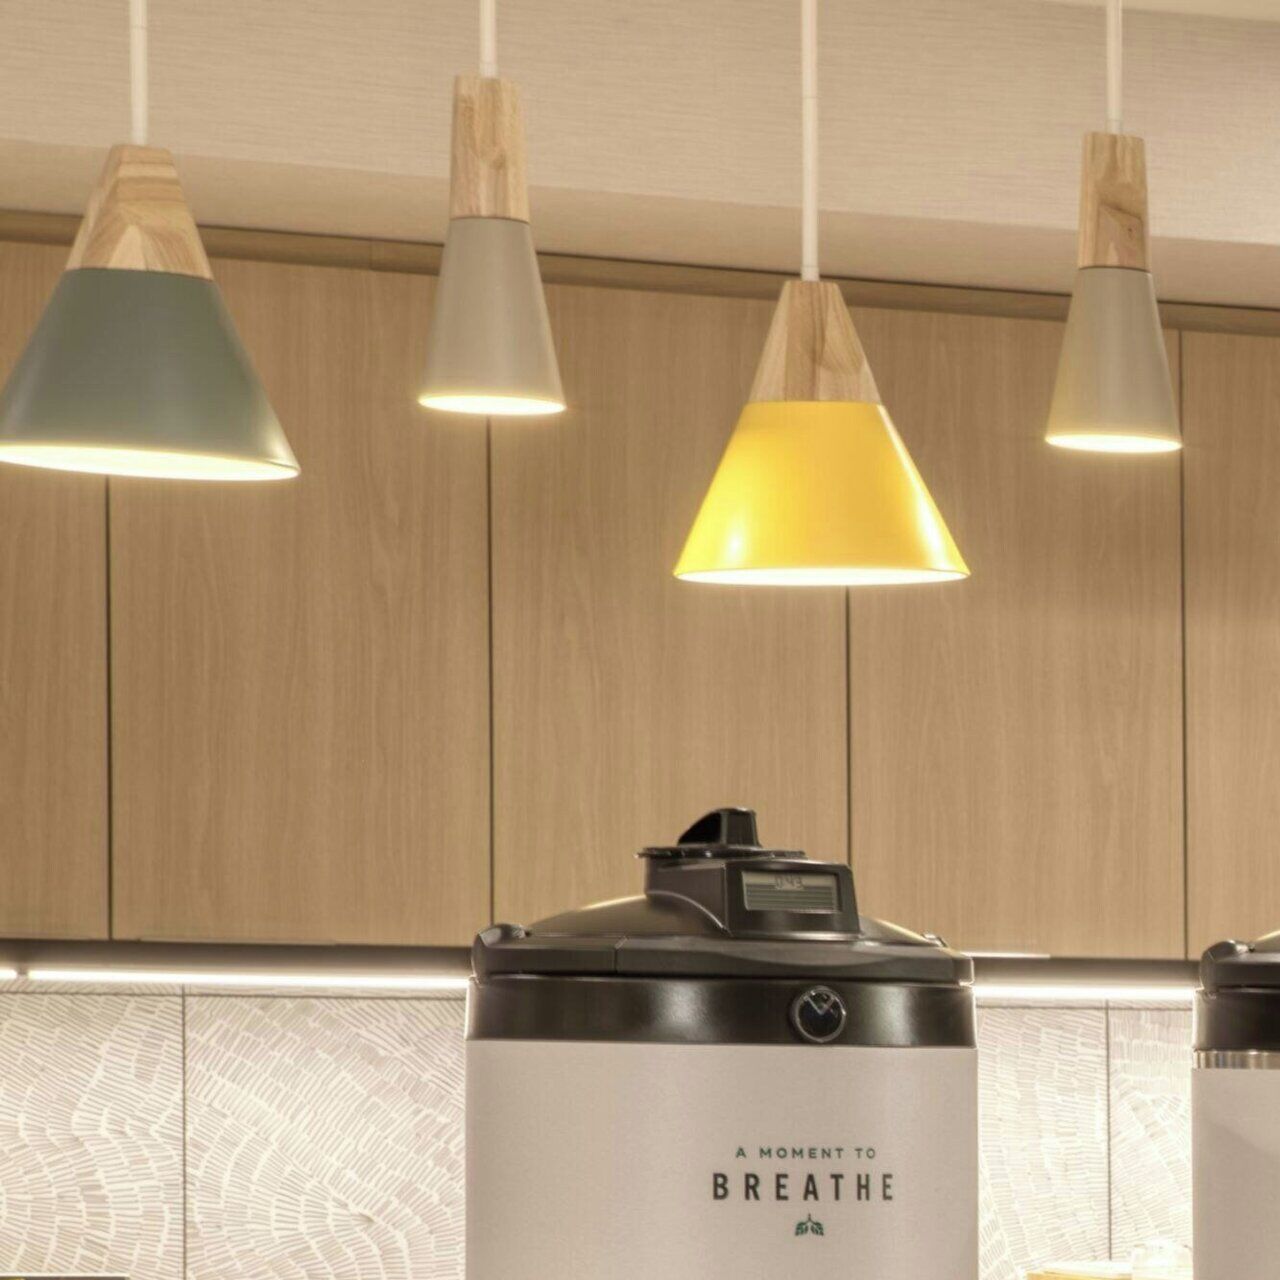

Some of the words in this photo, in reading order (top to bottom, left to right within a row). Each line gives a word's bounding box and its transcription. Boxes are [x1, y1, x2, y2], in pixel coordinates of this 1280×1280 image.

[735, 1147, 747, 1159] A
[759, 1147, 844, 1159] MOMENT
[855, 1148, 876, 1159] TO
[712, 1172, 894, 1201] BREATHE
